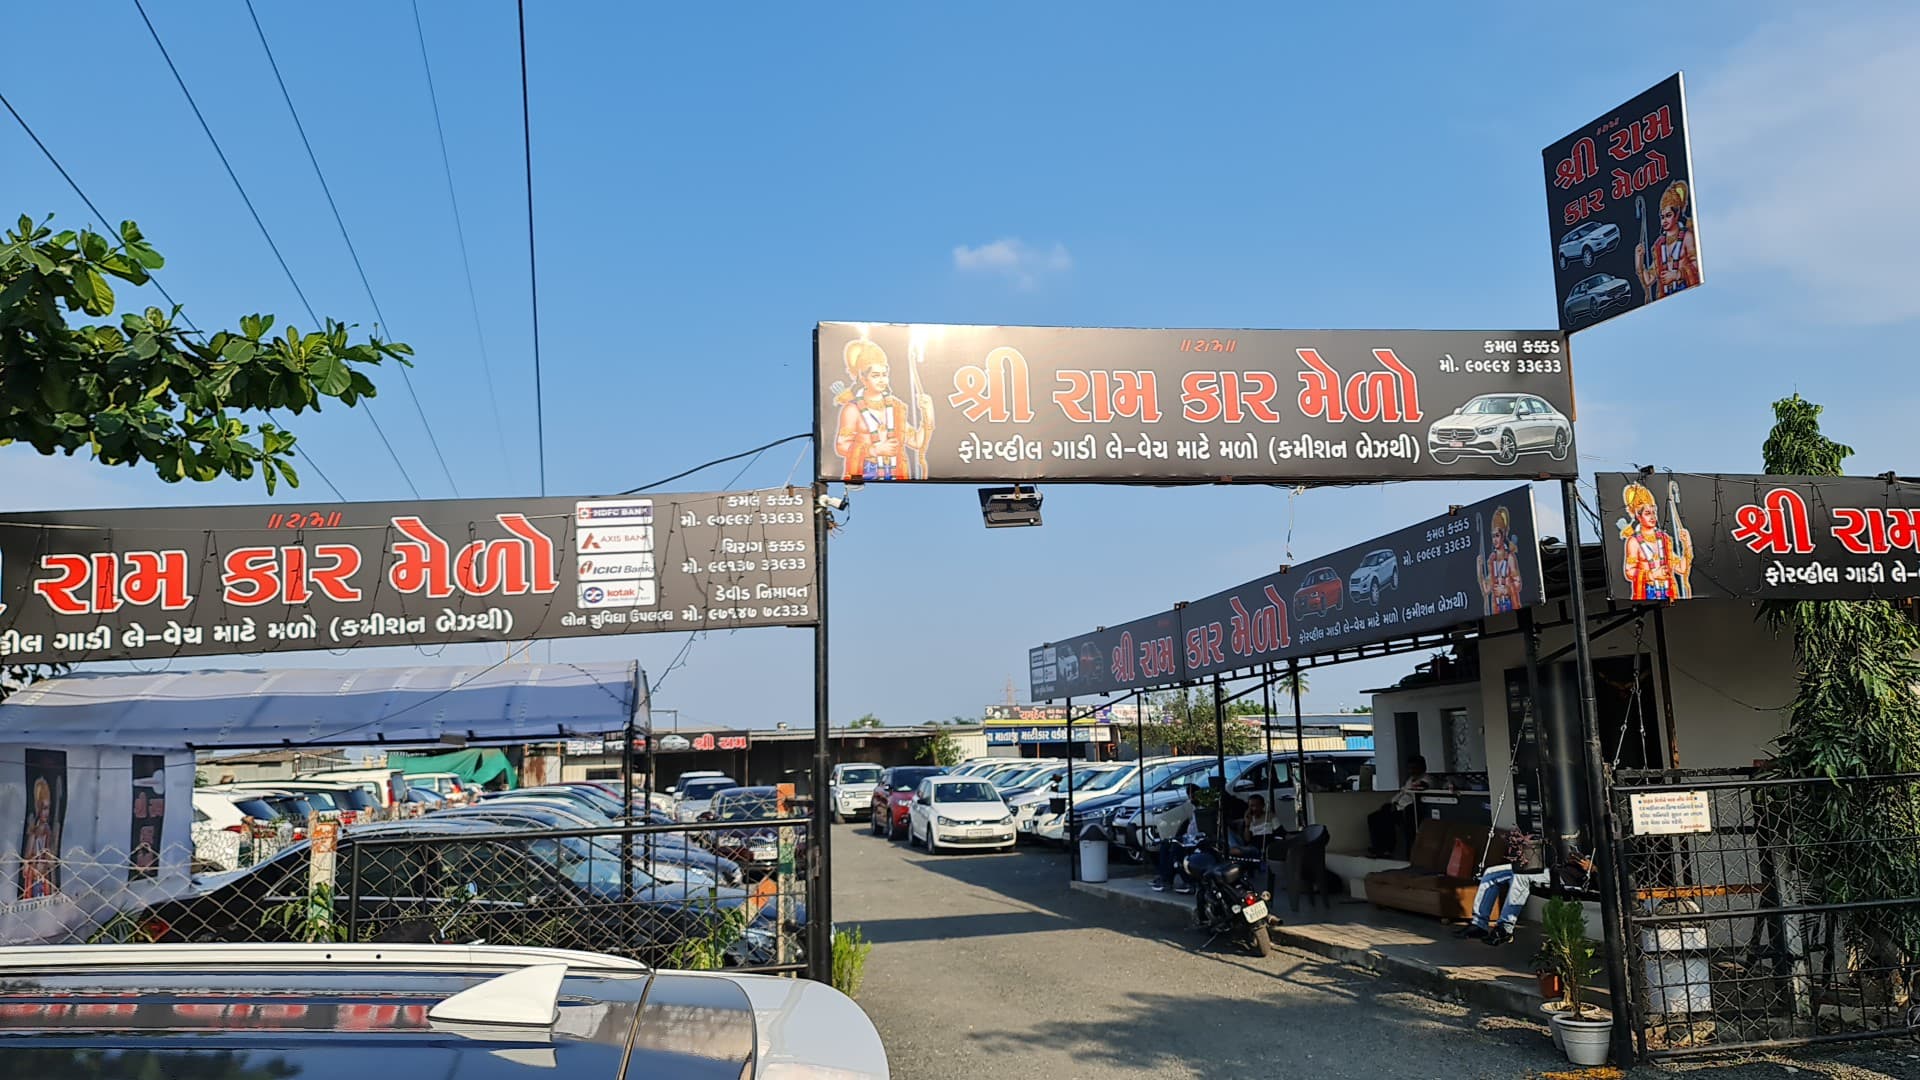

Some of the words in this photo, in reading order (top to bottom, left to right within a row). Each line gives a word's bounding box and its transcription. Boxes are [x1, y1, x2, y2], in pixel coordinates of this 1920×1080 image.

[1554, 137, 1598, 188] શ્રી
[1609, 105, 1673, 160] રામ
[1565, 188, 1604, 225] કાર
[1611, 150, 1669, 199] મેળો
[1484, 340, 1518, 355] કમલ
[1522, 340, 1560, 354] કક્કડ
[1439, 354, 1460, 373] મો.
[1465, 359, 1510, 373] ૯૦૯૯૪
[1517, 359, 1562, 373] ૩૩૯૩૩
[948, 346, 1035, 423] શ્રી
[1052, 369, 1163, 423] રામ
[1181, 370, 1280, 423] કાર
[1295, 347, 1424, 423] મેળો
[958, 432, 1043, 464] ફોરવ્હીલ
[1051, 434, 1097, 460] ગાડી
[1176, 433, 1210, 459] માટે
[1219, 432, 1258, 460] મળો
[1268, 434, 1347, 464] (કમીશન
[1356, 432, 1421, 464] બેઝથી)
[728, 495, 760, 508] કમલ
[592, 508, 619, 517] HDFC
[621, 508, 648, 516] BANK
[680, 513, 701, 527] મો.
[707, 513, 752, 526] ૯૦૯૯૪
[759, 513, 804, 525] ૩૩૯૩૩
[1731, 487, 1816, 554] શ્રી
[1426, 526, 1445, 542] કમલ
[722, 539, 762, 554] ચિરાગ
[1416, 545, 1441, 563] ૯૦૯૯૪
[1444, 535, 1471, 553] ૩૩૯૩૩
[34, 550, 193, 614] રામ
[222, 545, 361, 605] કાર
[390, 514, 560, 597] મેળો
[593, 566, 622, 574] ICICI
[624, 565, 653, 573] Bank
[681, 558, 702, 574] મો.
[708, 560, 755, 572] ૯૯૧૩૭
[761, 559, 806, 571] ૩૩૯૩૩
[1764, 559, 1838, 585] ફોરવ્હીલ
[1845, 561, 1885, 583] ગાડી
[607, 588, 635, 597] kotak
[561, 611, 586, 625] લોન
[590, 610, 626, 628] સુવિધા
[681, 605, 702, 621] મો.
[763, 606, 809, 618] ૭૮૩૩૩
[53, 626, 111, 652] ગાડી
[214, 617, 256, 643] માટે
[268, 614, 318, 641] મળો
[330, 612, 426, 642] (કમીશન
[435, 608, 514, 633] બેઝથી)
[1326, 623, 1341, 638] ગાડી
[1367, 613, 1380, 630] માટે
[1383, 608, 1399, 625] મળો
[1112, 630, 1135, 682] શ્રી
[1139, 635, 1176, 678] રામ
[1186, 621, 1224, 670] કાર
[1231, 585, 1290, 655] મેળો
[692, 733, 715, 750] શ્રી
[718, 736, 747, 750] રામ
